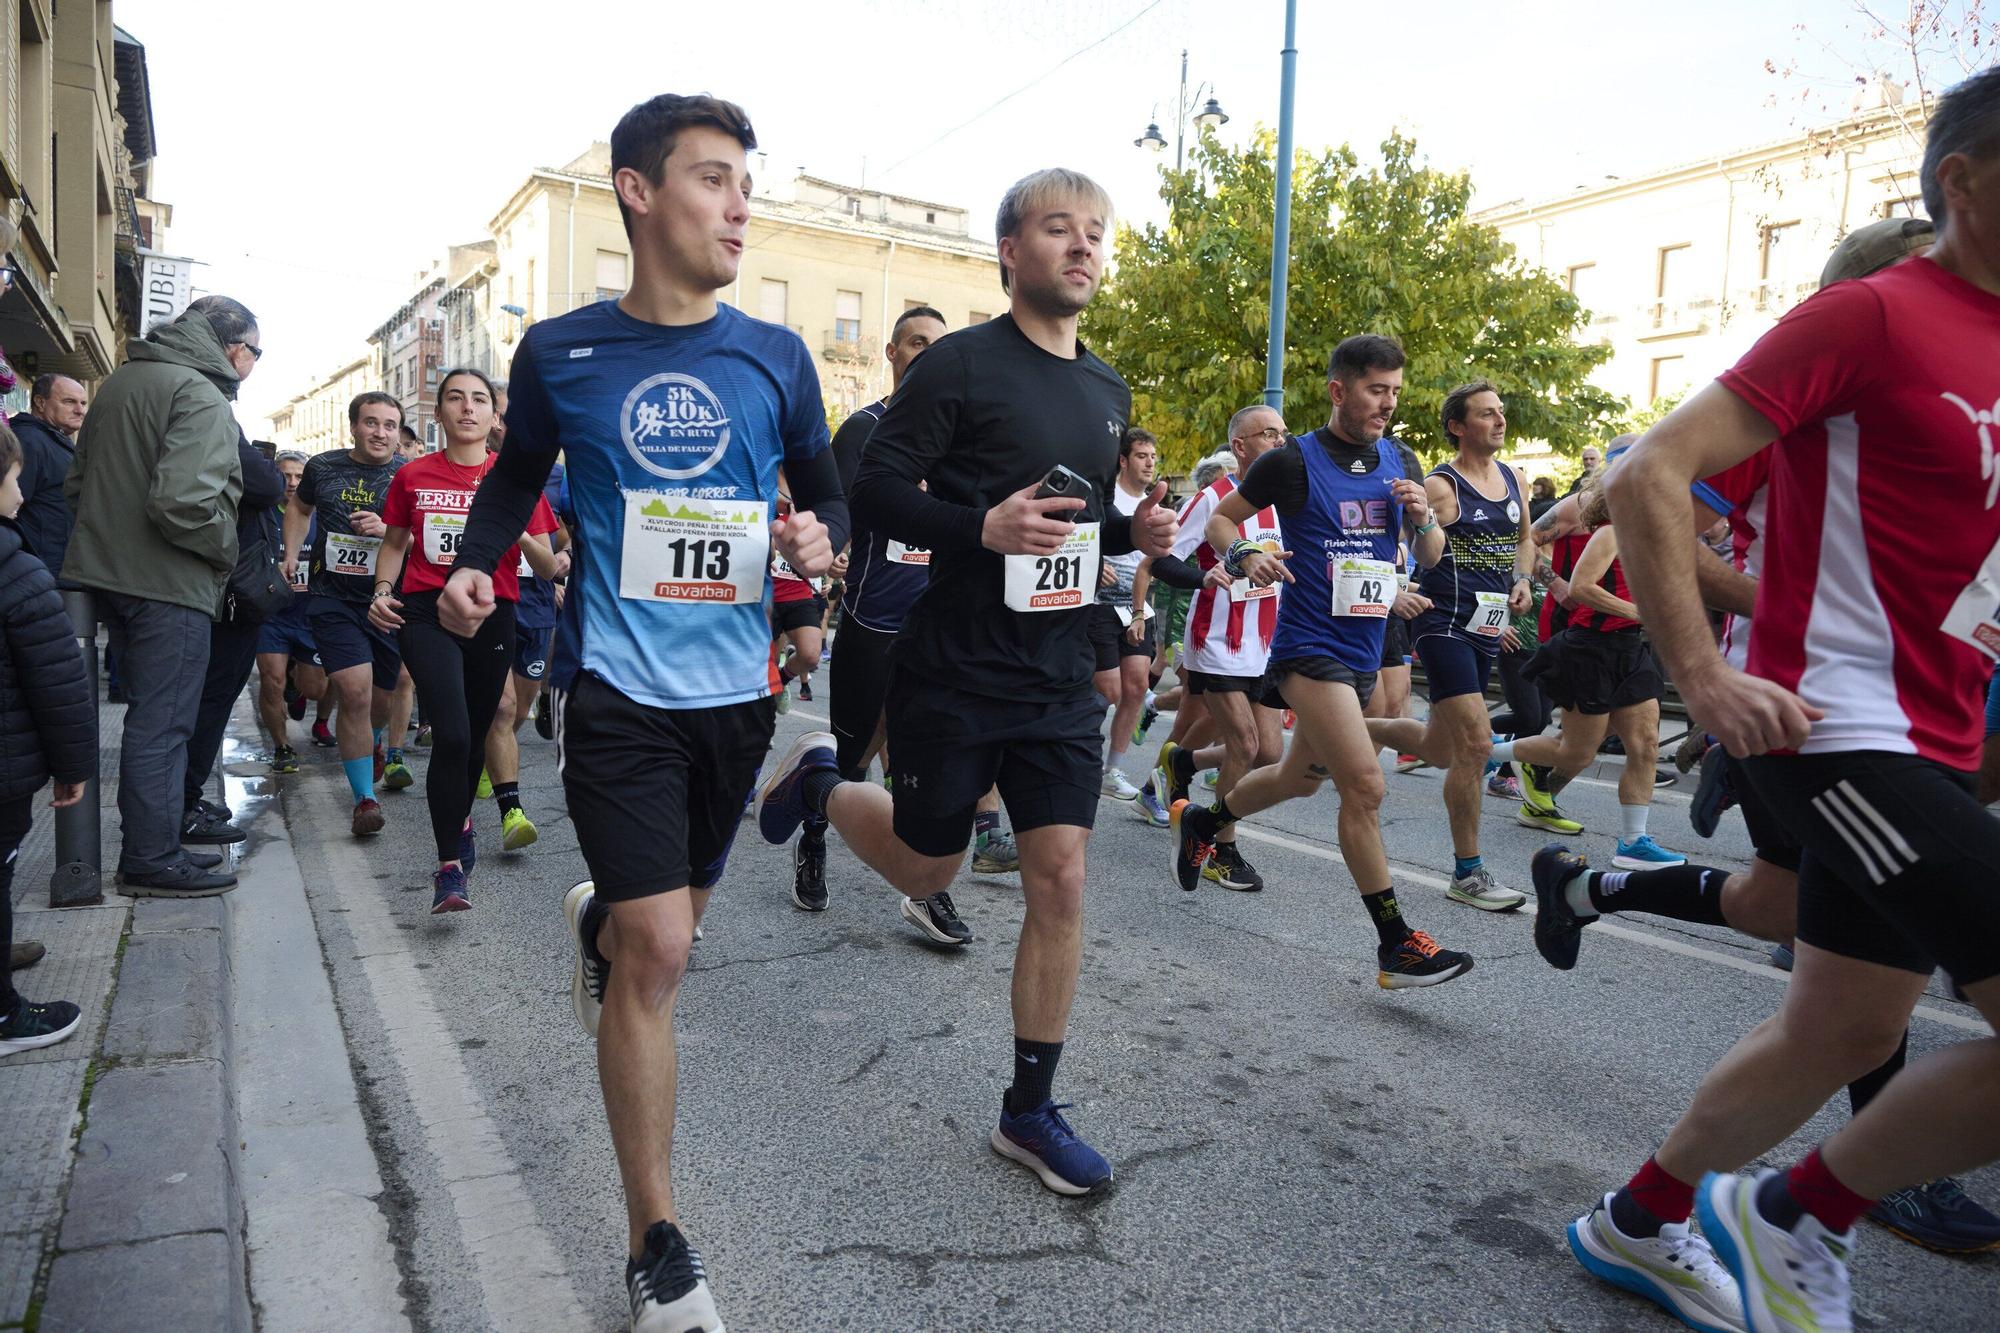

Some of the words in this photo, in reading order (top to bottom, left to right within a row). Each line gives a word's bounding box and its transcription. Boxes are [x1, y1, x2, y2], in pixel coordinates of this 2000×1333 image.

[149, 261, 176, 322] UBE
[667, 387, 698, 401] 5K
[666, 401, 716, 420] 10K
[670, 429, 686, 438] EN
[687, 429, 716, 437] RUTA
[1339, 500, 1387, 528] DE
[640, 524, 682, 535] TAFALLAKO
[707, 530, 728, 538] HERRI
[664, 520, 685, 528] CROSS
[711, 522, 721, 530] DE
[722, 523, 748, 532] TAFALLA
[337, 549, 368, 566] 242
[668, 538, 731, 581] 113
[1035, 556, 1081, 591] 281
[659, 584, 734, 598] navarban
[1033, 592, 1081, 606] navarban
[1359, 580, 1384, 604] 42
[1486, 609, 1505, 626] 127
